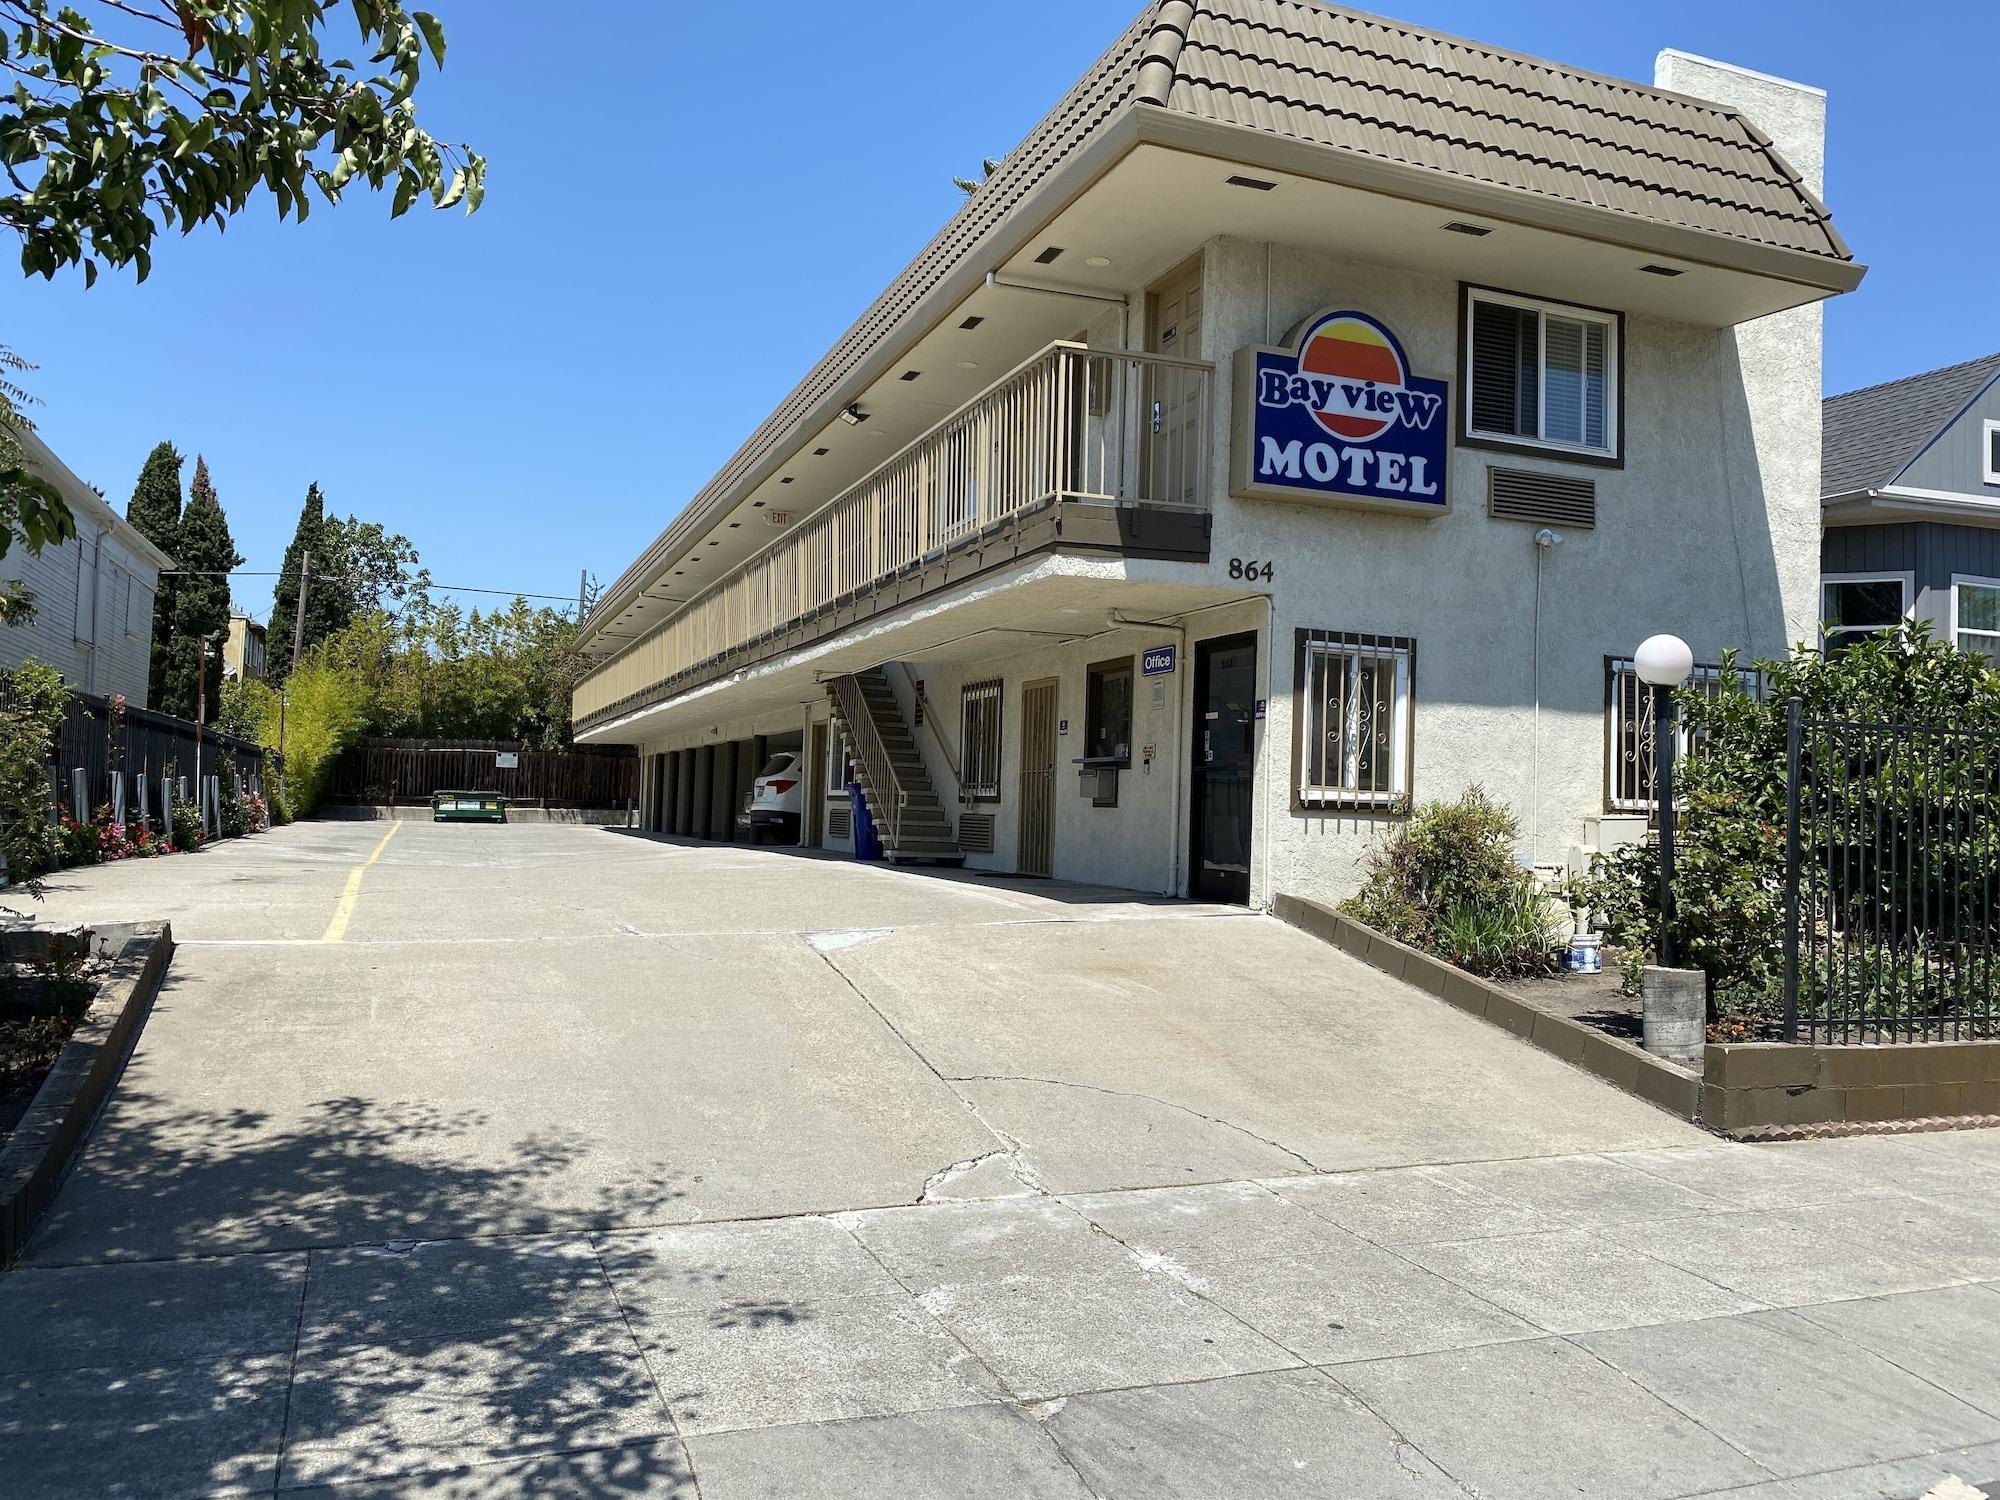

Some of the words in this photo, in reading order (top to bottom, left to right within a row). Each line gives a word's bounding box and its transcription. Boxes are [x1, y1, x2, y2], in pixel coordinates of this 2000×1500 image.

[1259, 369, 1335, 410] Bay
[1259, 436, 1438, 496] MOTEL
[772, 512, 787, 525] EXIT
[1229, 558, 1274, 583] 864
[1144, 655, 1171, 670] Office
